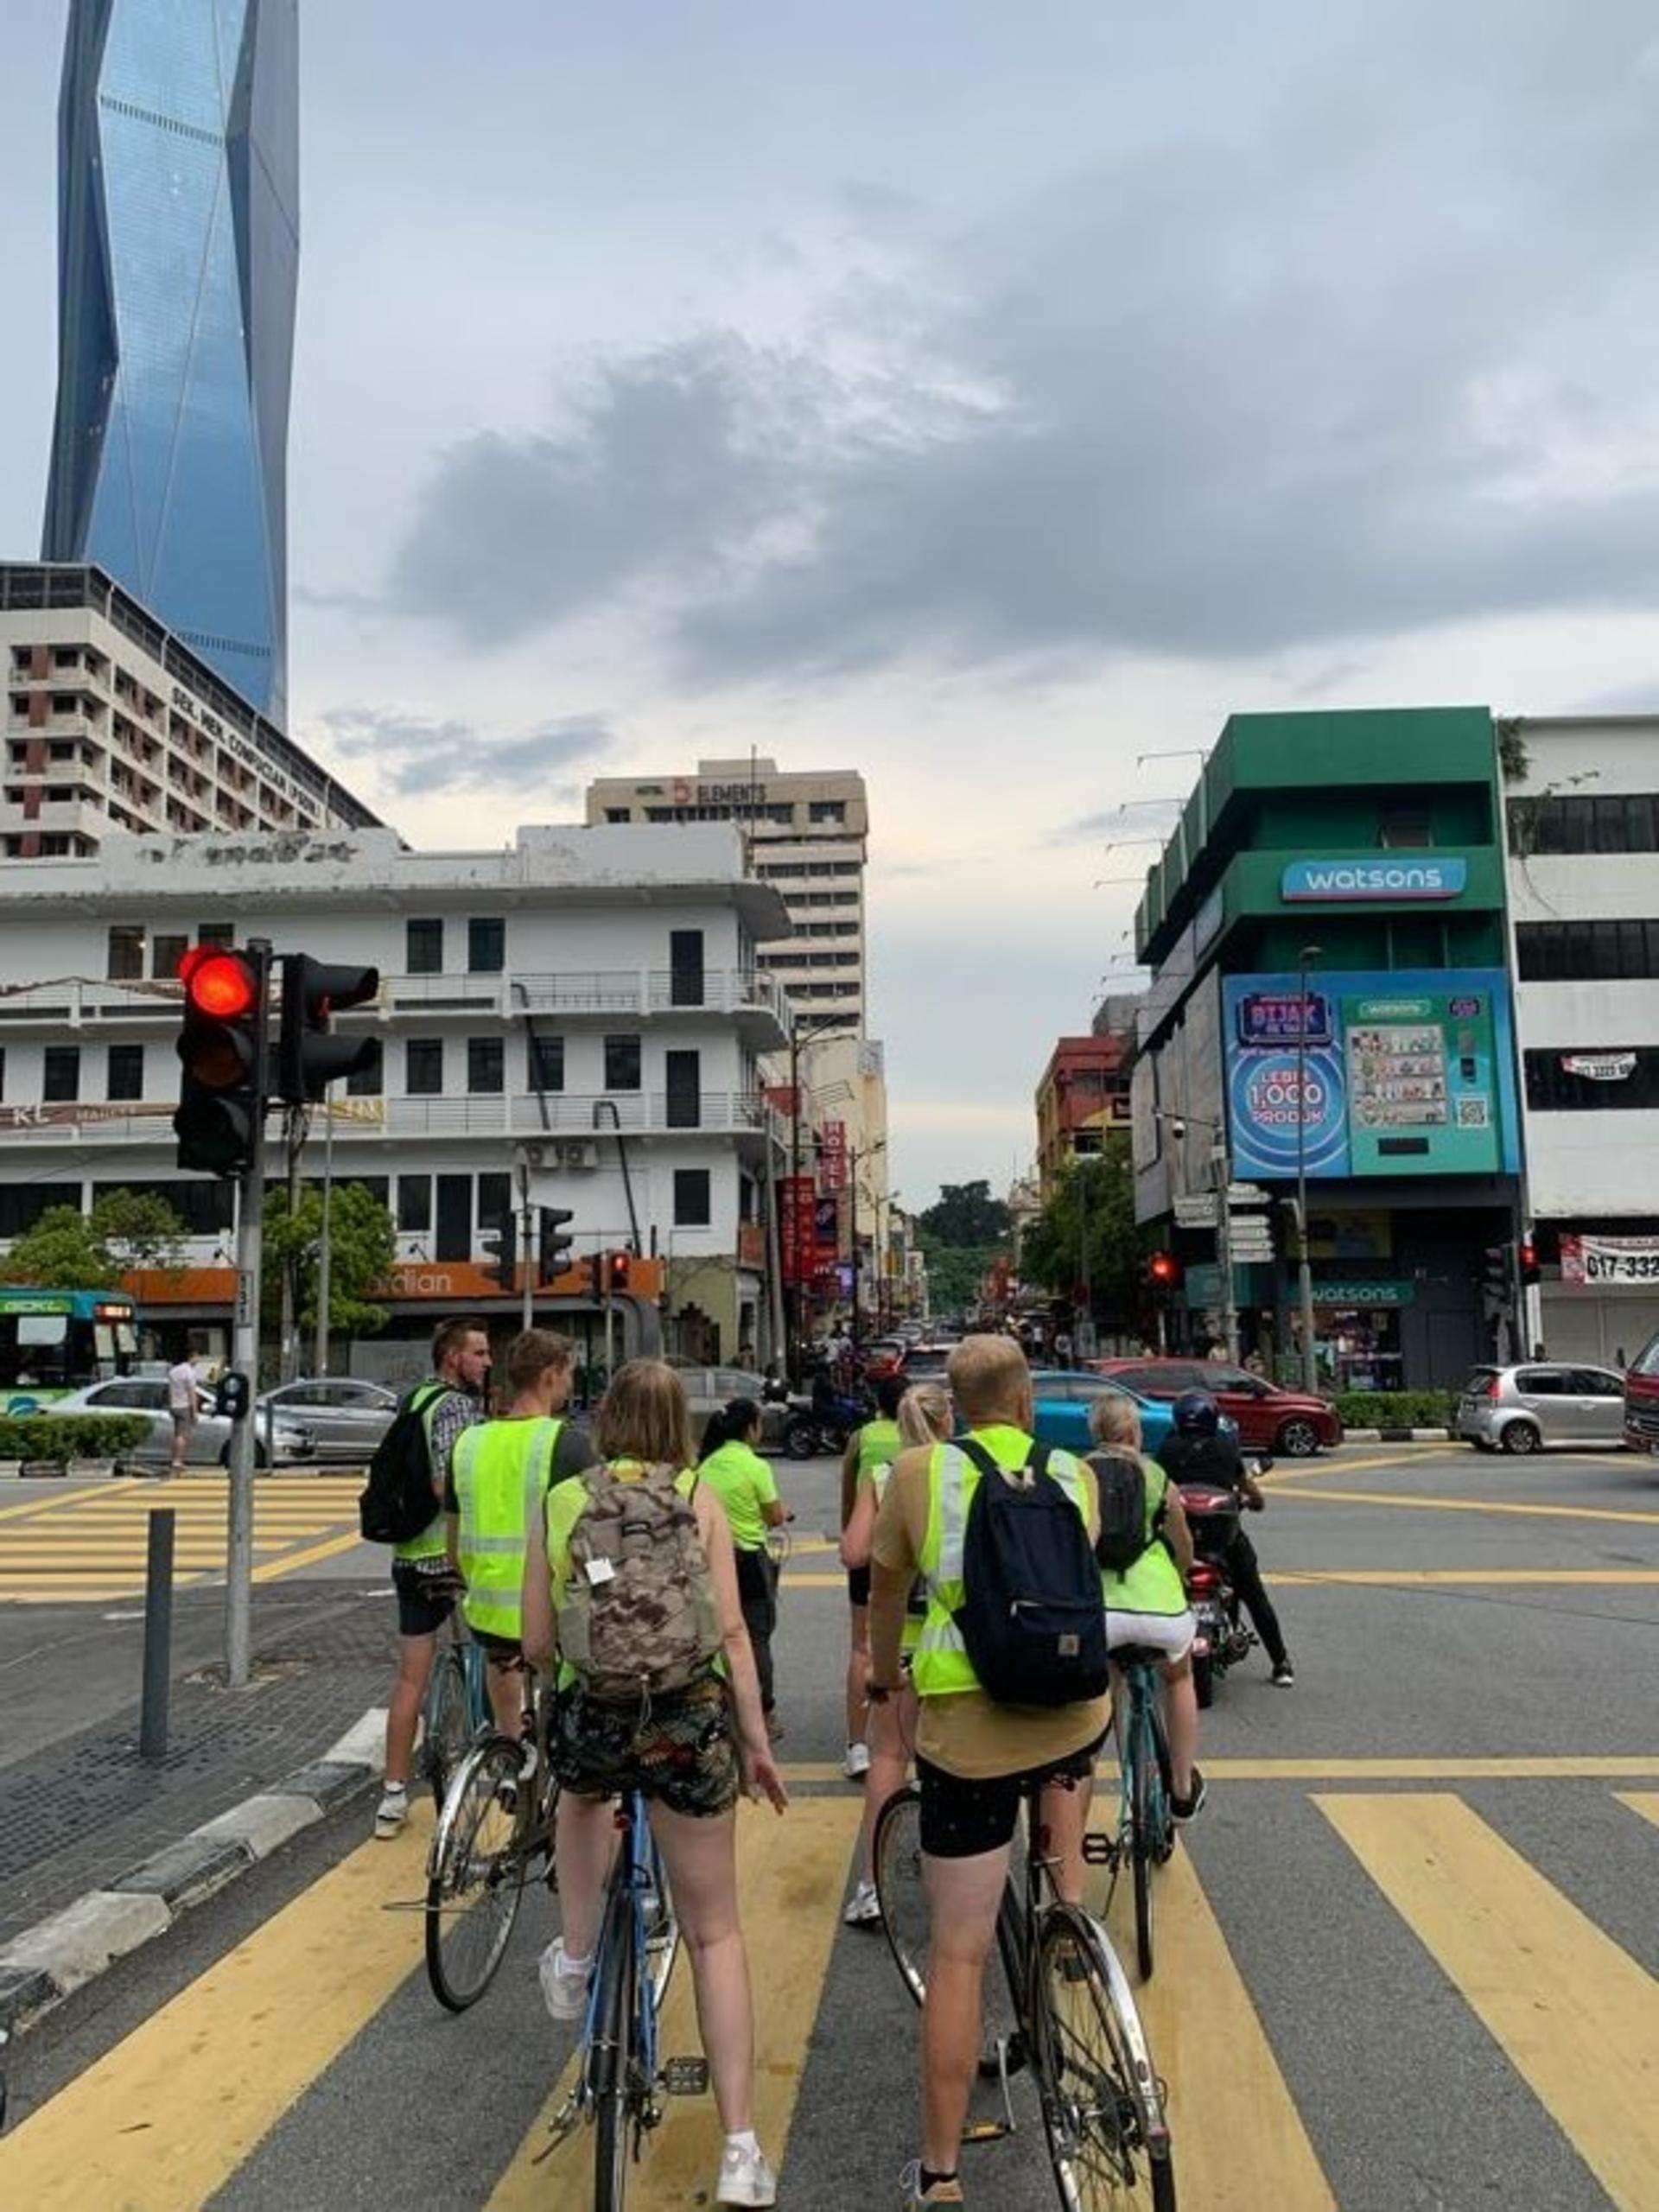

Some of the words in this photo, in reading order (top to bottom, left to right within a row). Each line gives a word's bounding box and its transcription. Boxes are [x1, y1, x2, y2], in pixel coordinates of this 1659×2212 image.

[697, 784, 767, 804] ELEMENTS
[1306, 868, 1442, 890] watsons
[1251, 1084, 1323, 1109] 1,000
